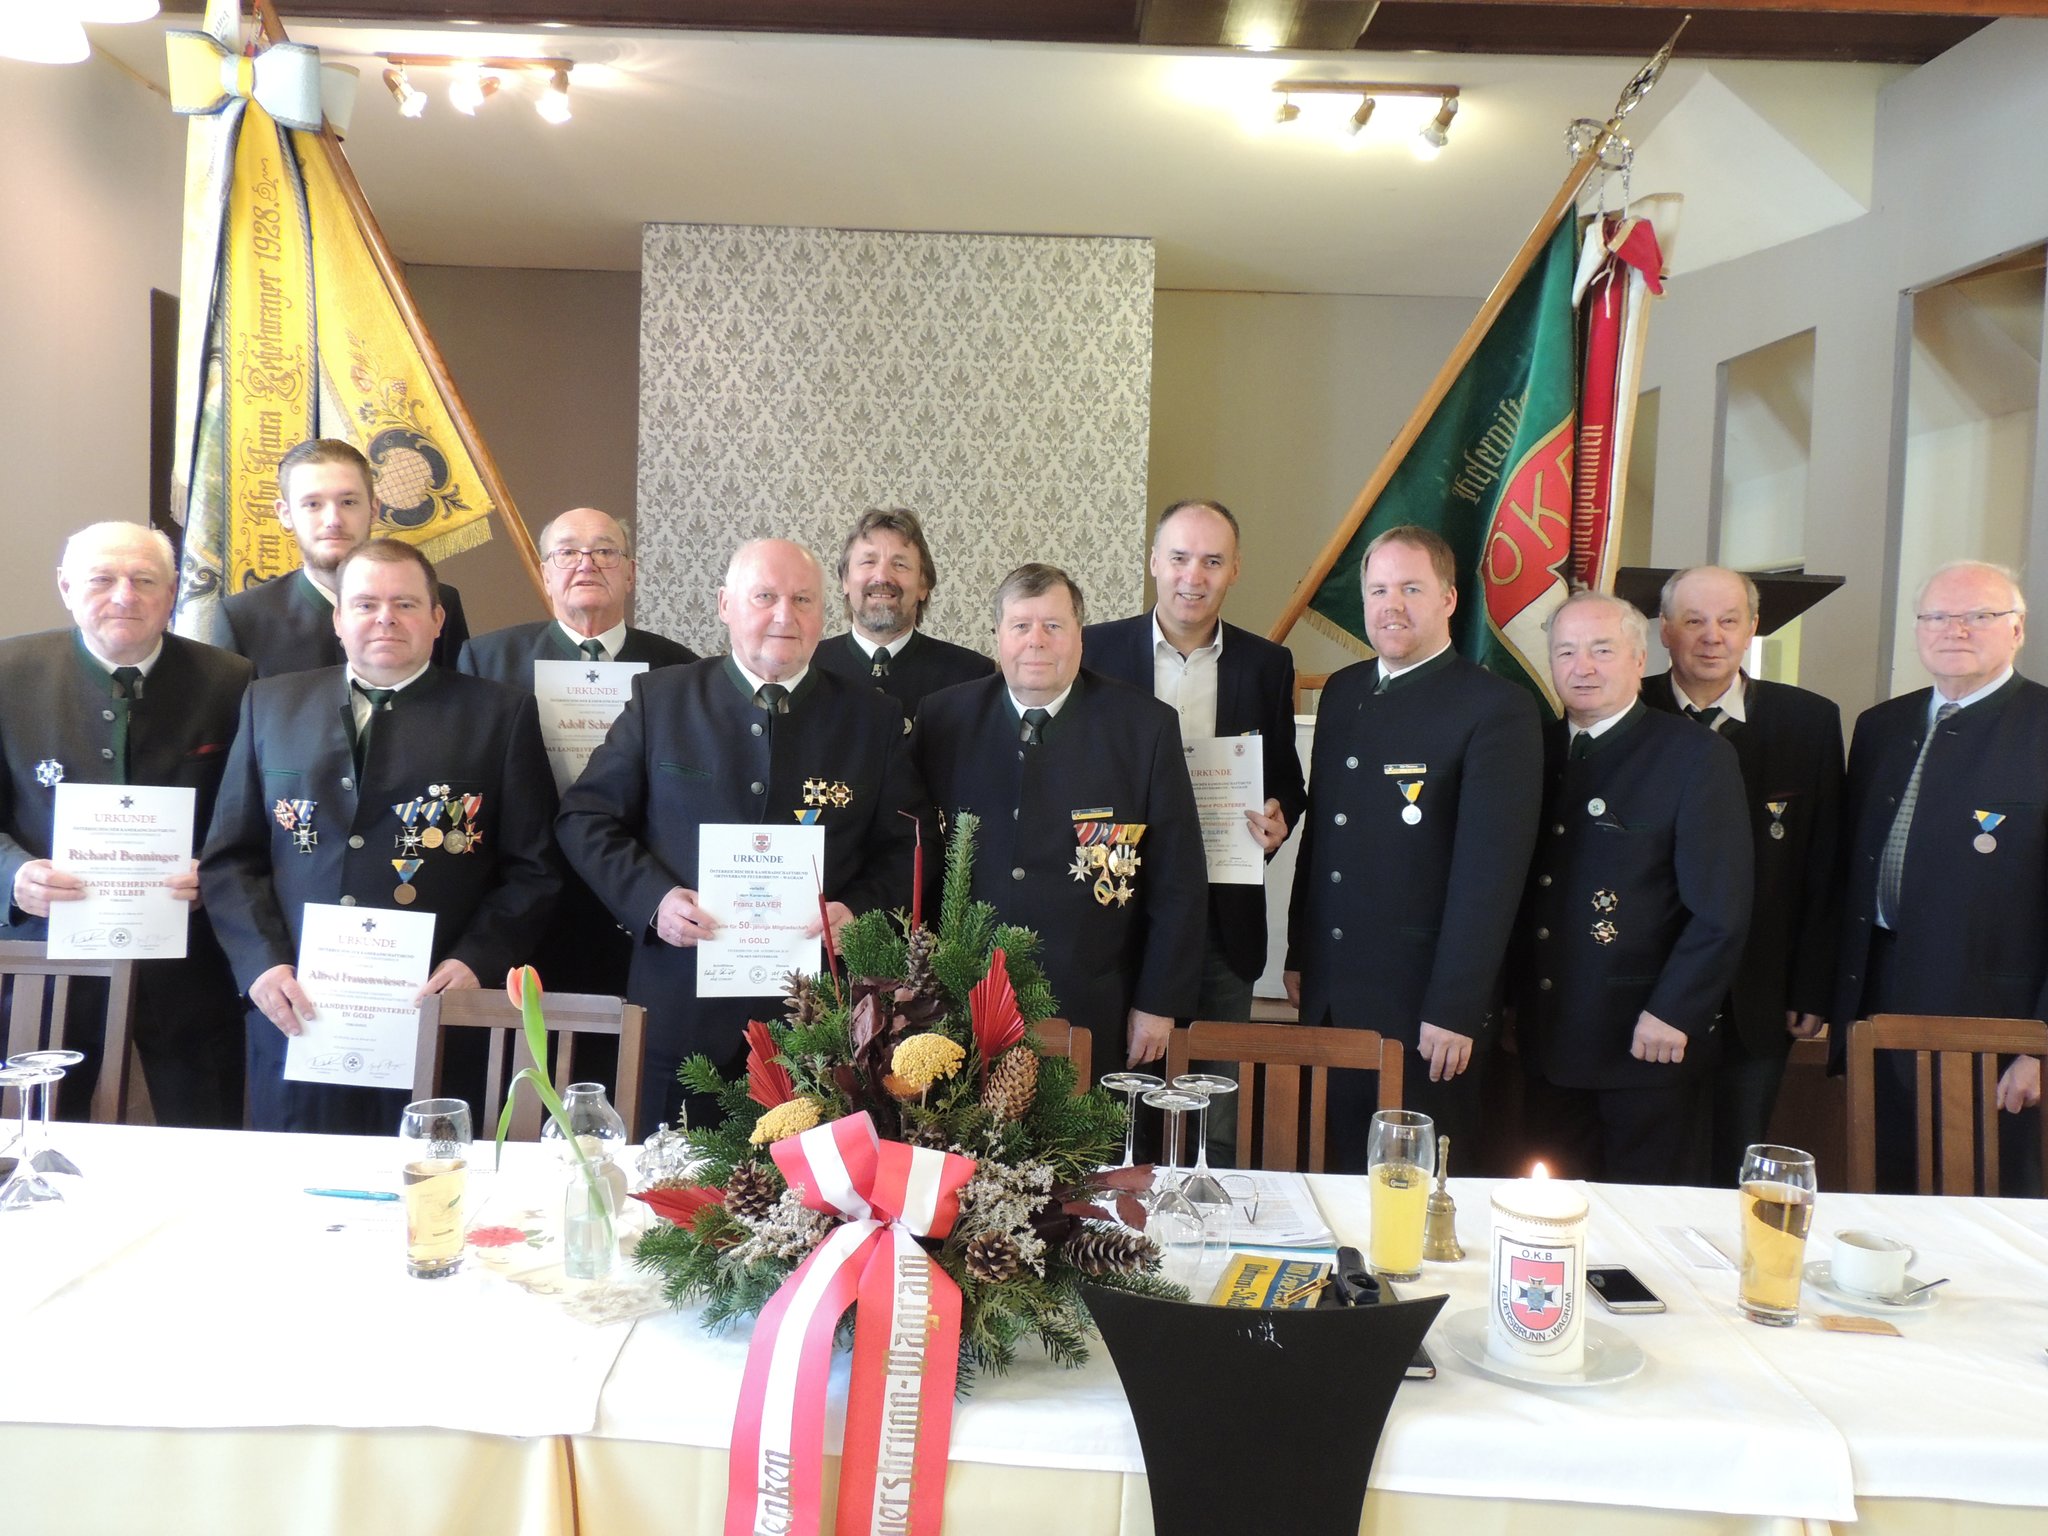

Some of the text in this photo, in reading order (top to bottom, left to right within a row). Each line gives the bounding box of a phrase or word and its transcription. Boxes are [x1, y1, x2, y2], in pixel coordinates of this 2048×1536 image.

[567, 686, 619, 696] URKUNDE
[1190, 768, 1233, 777] URKUNDE
[94, 813, 158, 824] URKUNDE
[68, 848, 117, 861] Richard
[733, 854, 784, 864] URKUNDE
[733, 900, 782, 909] Franz BAYER
[748, 937, 770, 945] GOLD
[1501, 1283, 1546, 1341] FEUERSBRUNN
[1550, 1291, 1573, 1336] WAGRAM
[754, 1448, 796, 1536] enken
